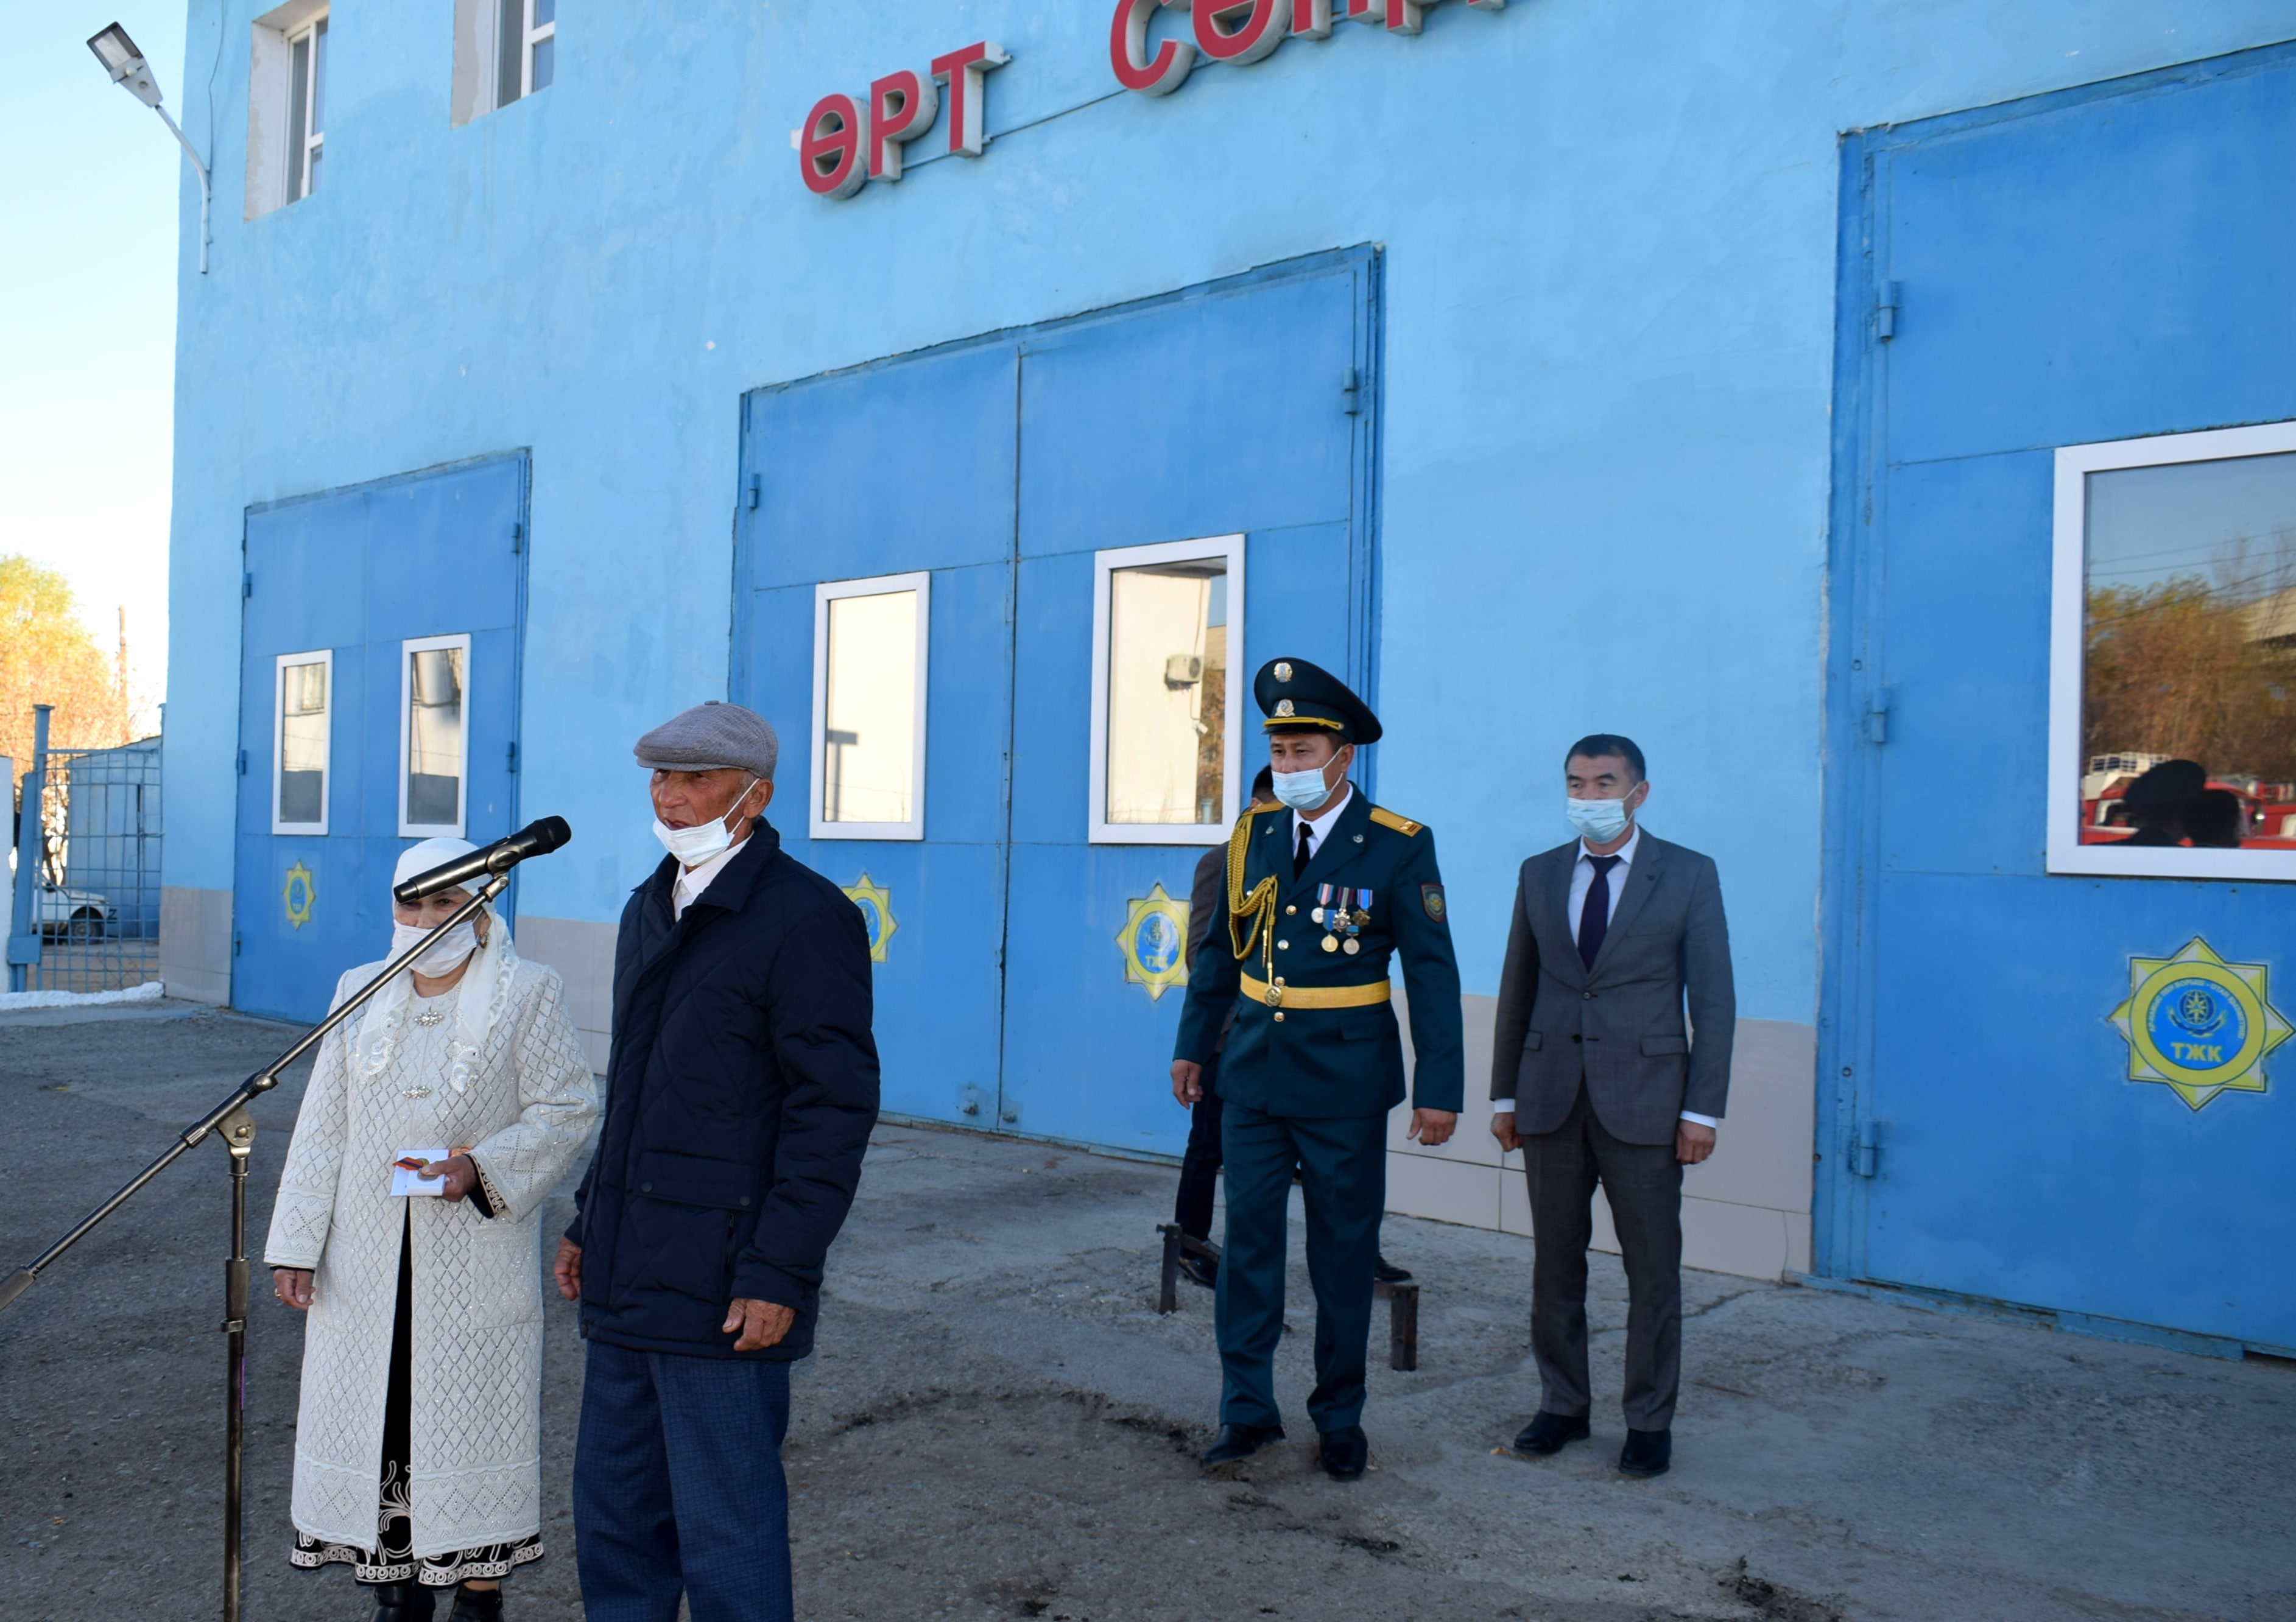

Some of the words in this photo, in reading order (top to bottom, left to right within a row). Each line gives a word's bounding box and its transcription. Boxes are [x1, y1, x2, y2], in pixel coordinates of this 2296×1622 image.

[800, 40, 999, 196] ӨРТ
[1110, 0, 1495, 93] СӨ
[2170, 1042, 2223, 1062] ТЖК
